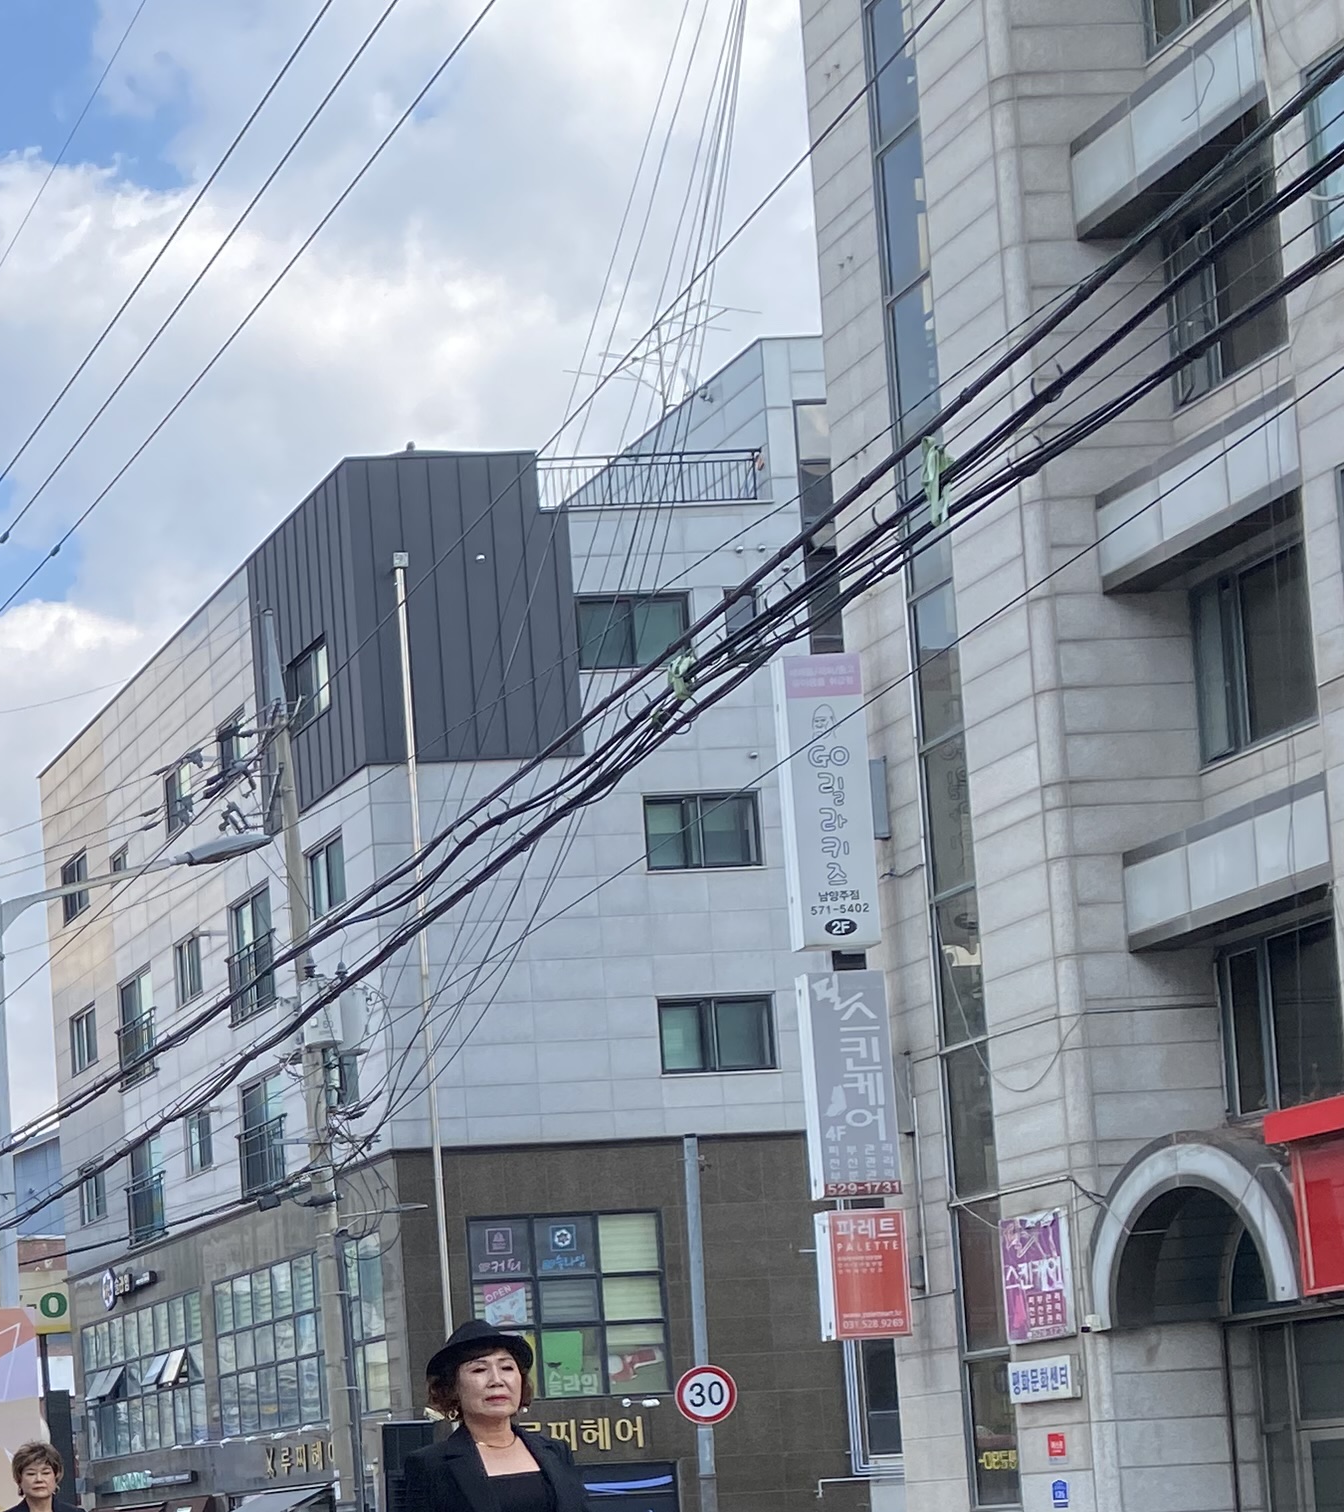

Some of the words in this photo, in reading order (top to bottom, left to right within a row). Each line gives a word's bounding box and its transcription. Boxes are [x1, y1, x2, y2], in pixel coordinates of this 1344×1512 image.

[818, 890, 861, 903] 남양주점
[810, 903, 870, 916] 571-5402
[831, 920, 850, 934] 2F
[839, 1001, 887, 1141] 스킨케어
[825, 1125, 847, 1142] 4F
[826, 1181, 901, 1197] 529-1731
[836, 1217, 898, 1240] 파레트
[836, 1240, 900, 1252] PALETTE
[485, 1285, 512, 1303] OPEN
[689, 1381, 725, 1409] 30
